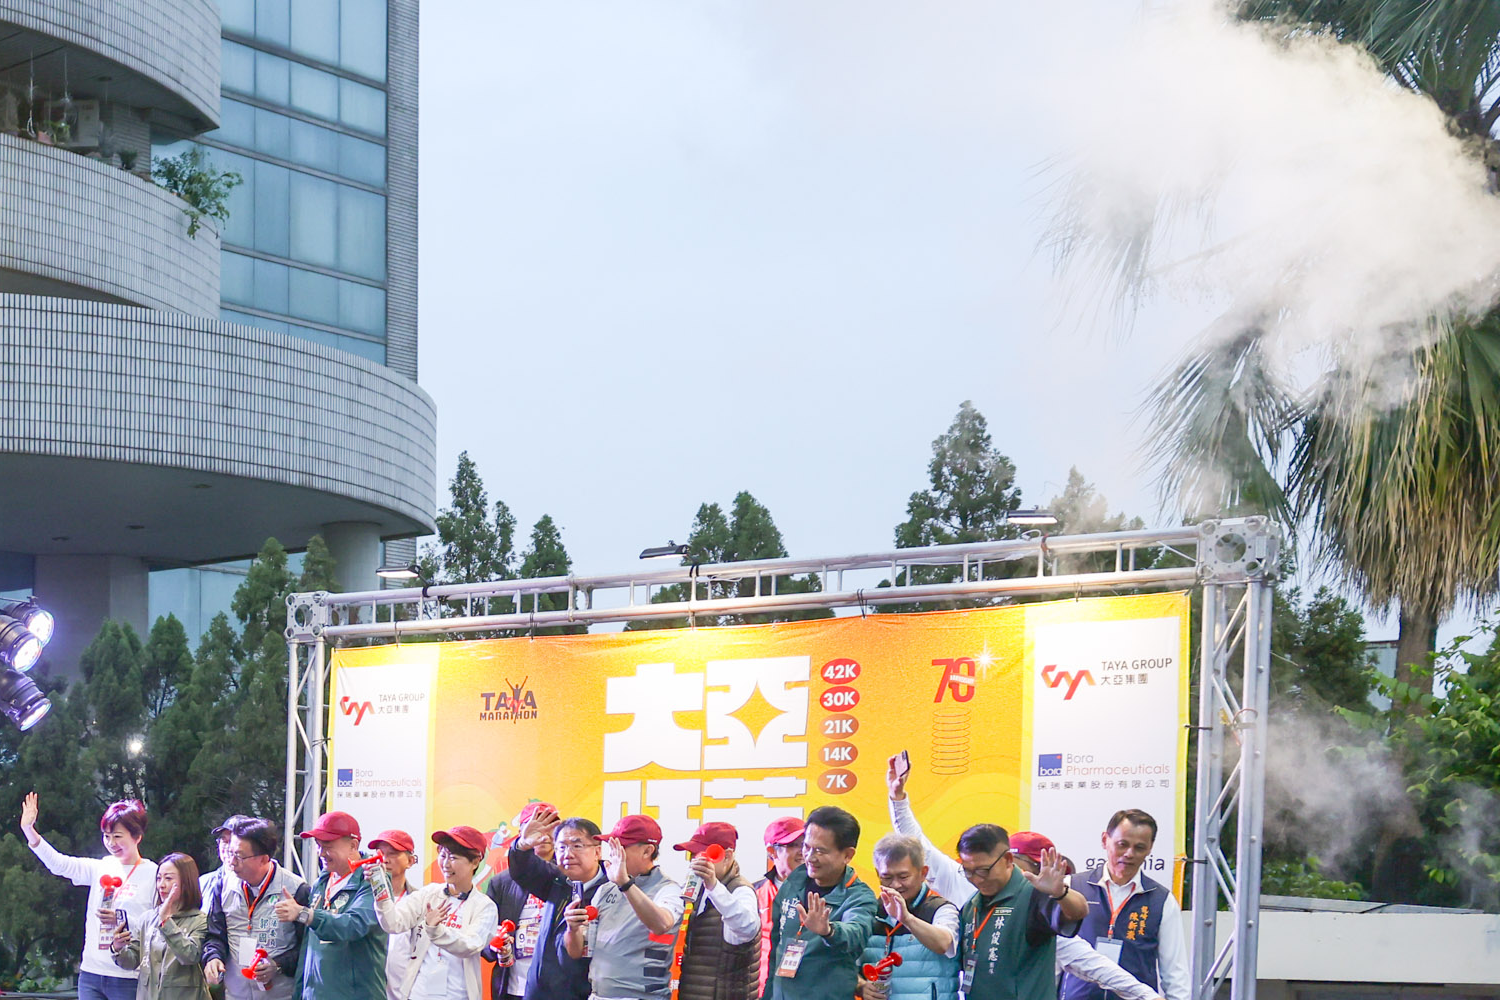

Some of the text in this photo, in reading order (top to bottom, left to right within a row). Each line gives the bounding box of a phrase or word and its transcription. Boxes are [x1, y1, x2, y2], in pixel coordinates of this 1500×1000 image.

[824, 663, 858, 679] 42K
[1101, 657, 1173, 671] TAYA GROUP
[1100, 673, 1148, 686] 大亞集團
[379, 693, 425, 703] TAYA GROUP
[823, 691, 855, 707] 30K
[479, 710, 538, 721] MARATHON
[824, 719, 854, 735] 21K
[823, 746, 853, 762] 14K
[1066, 753, 1094, 764] Bora
[1066, 764, 1170, 776] Pharmaceuticals
[826, 774, 848, 789] 7K
